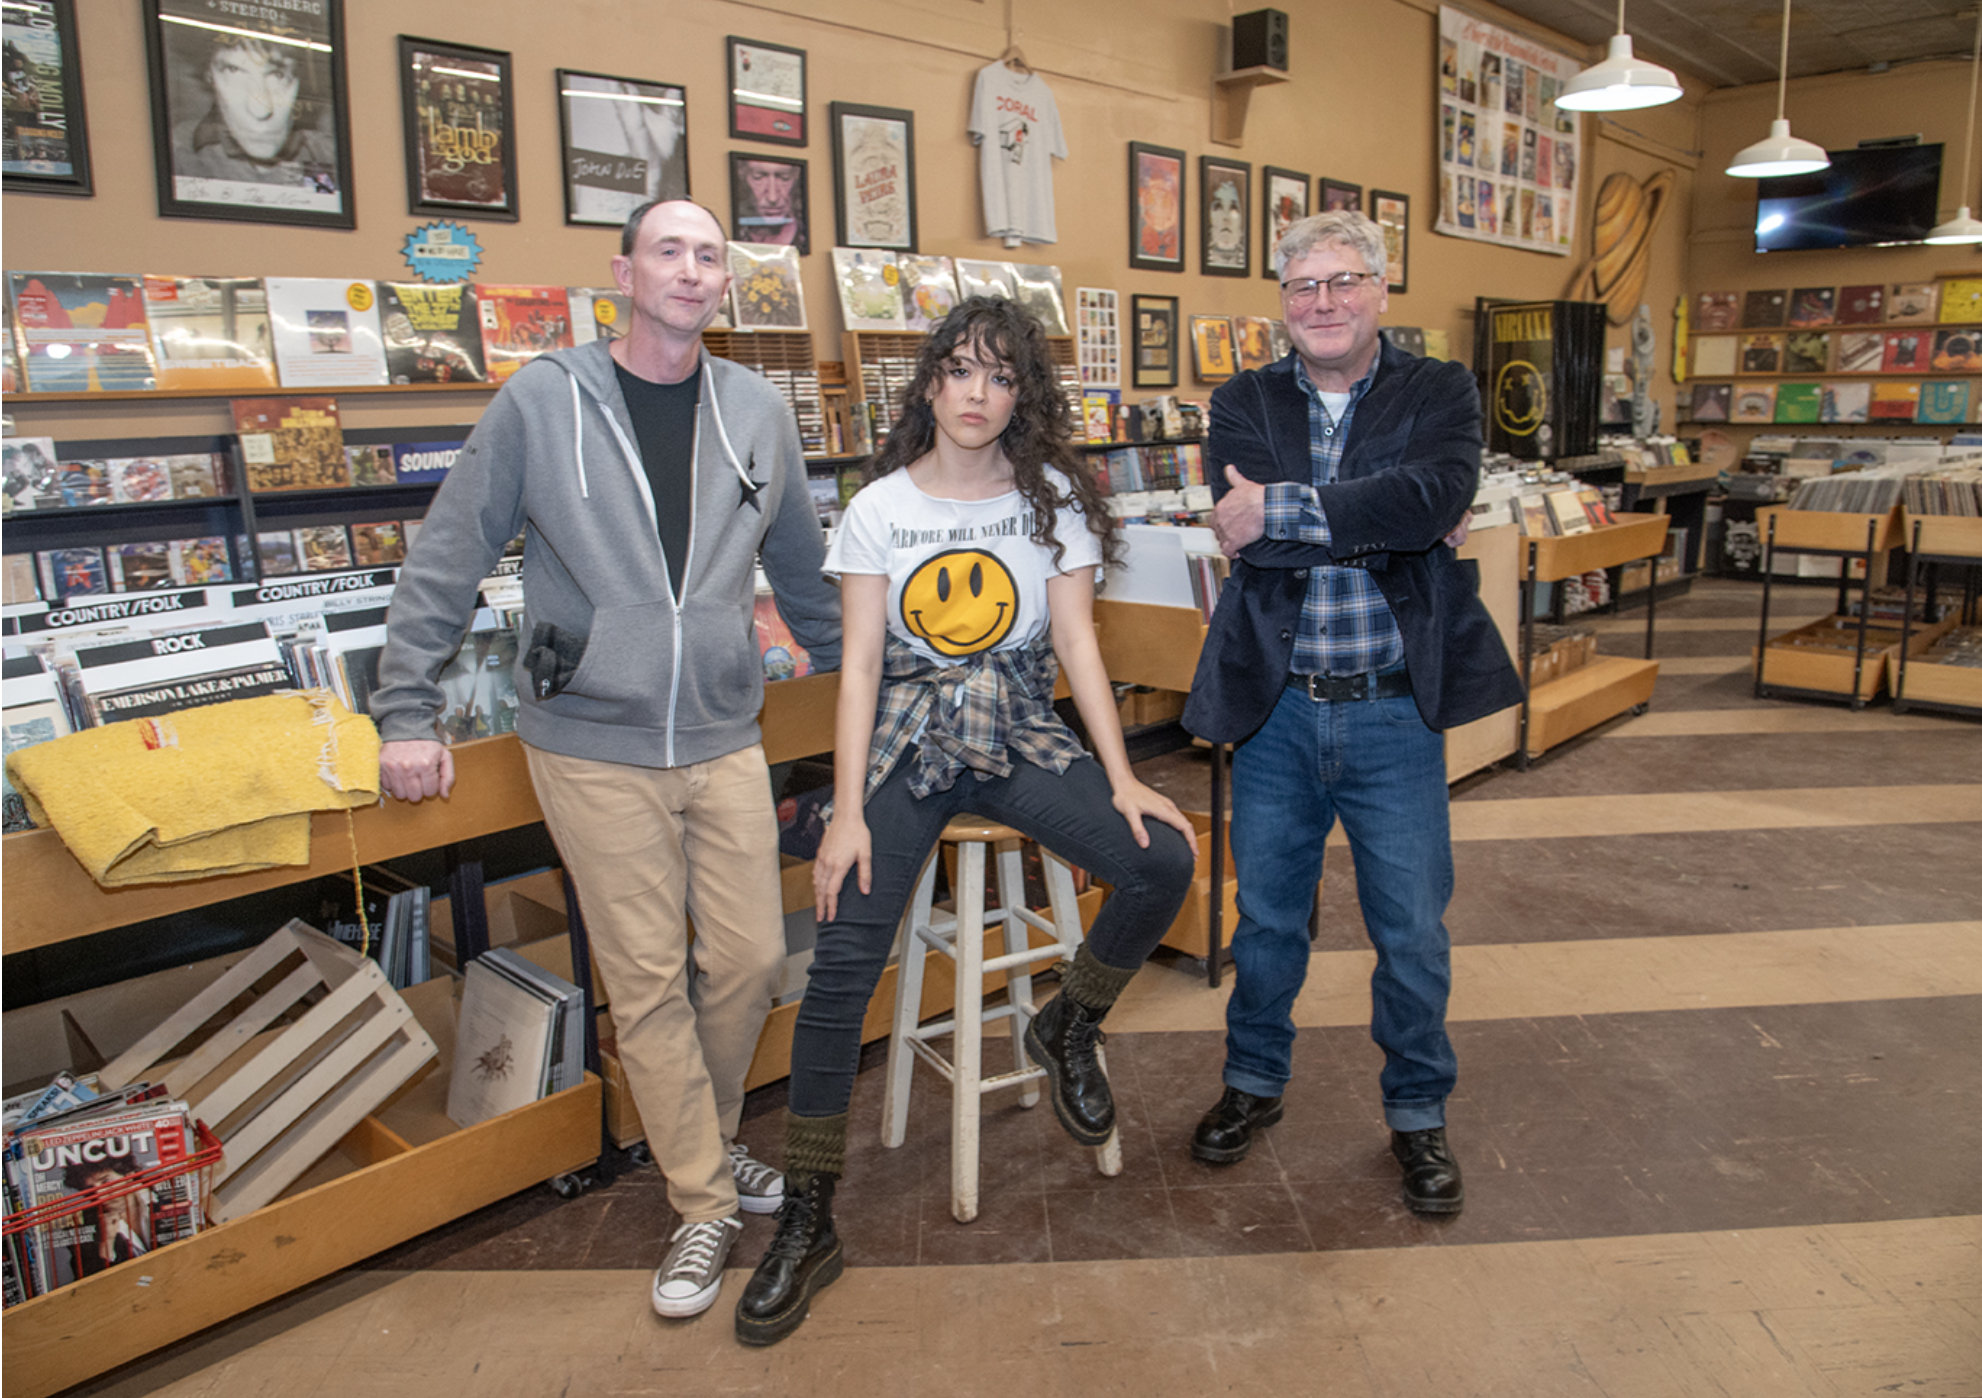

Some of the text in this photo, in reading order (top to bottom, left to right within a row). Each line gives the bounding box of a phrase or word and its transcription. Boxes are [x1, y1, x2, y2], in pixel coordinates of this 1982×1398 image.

[37, 79, 67, 130] MOLLY
[948, 527, 977, 542] WILL
[981, 515, 1018, 539] NEVER
[256, 573, 376, 603] COUNTRY/FOLK
[44, 594, 184, 628] COUNTRY/FOLK
[151, 633, 206, 656] ROCK
[99, 687, 176, 712] EMERSON
[174, 679, 218, 700] LAKE
[231, 669, 289, 689] PALMER
[32, 1130, 155, 1172] UNCUT
